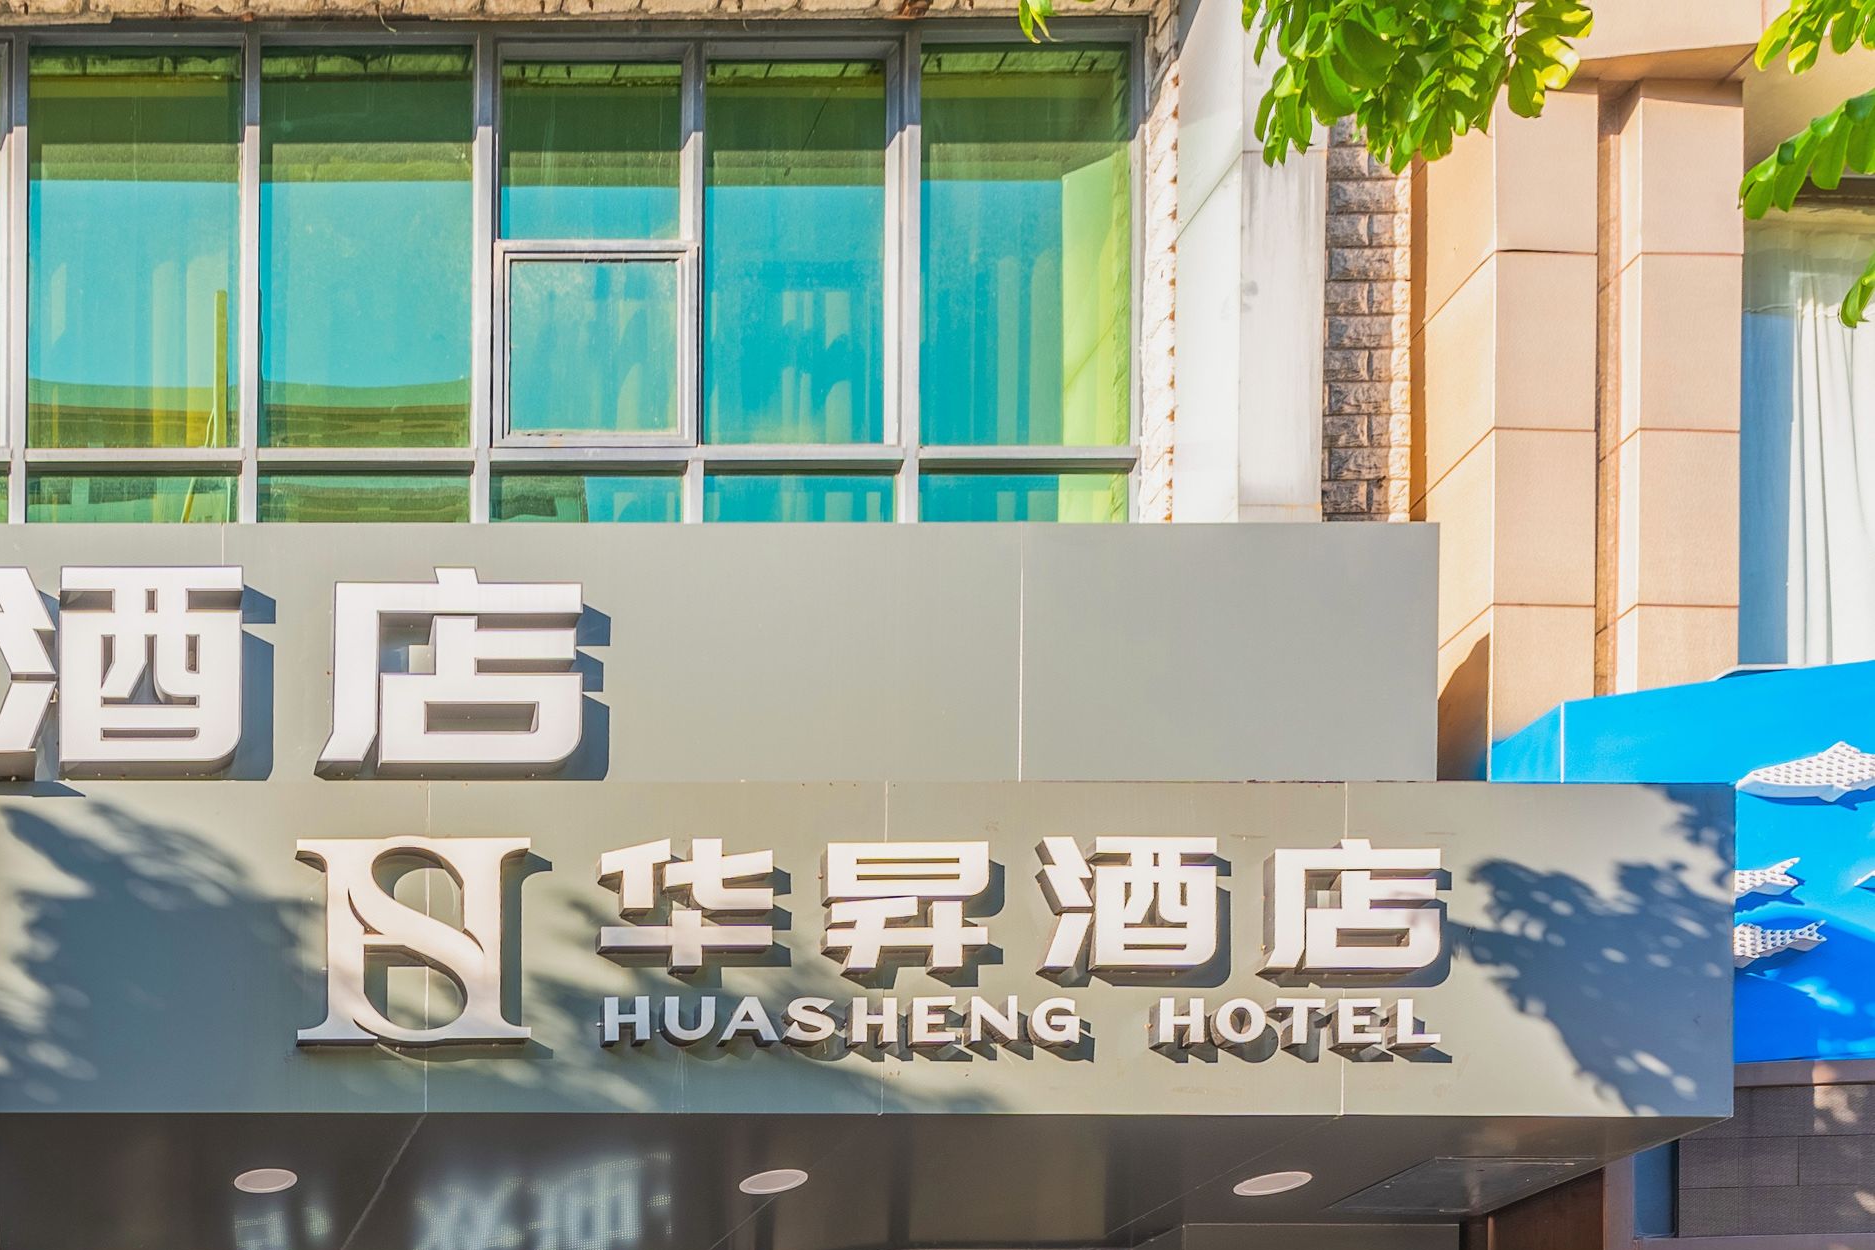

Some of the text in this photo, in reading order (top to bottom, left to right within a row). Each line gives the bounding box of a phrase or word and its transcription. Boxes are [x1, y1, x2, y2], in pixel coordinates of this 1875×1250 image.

[597, 836, 1442, 976] 华昇酒店
[601, 994, 1442, 1050] HUASHENG HOTEL
